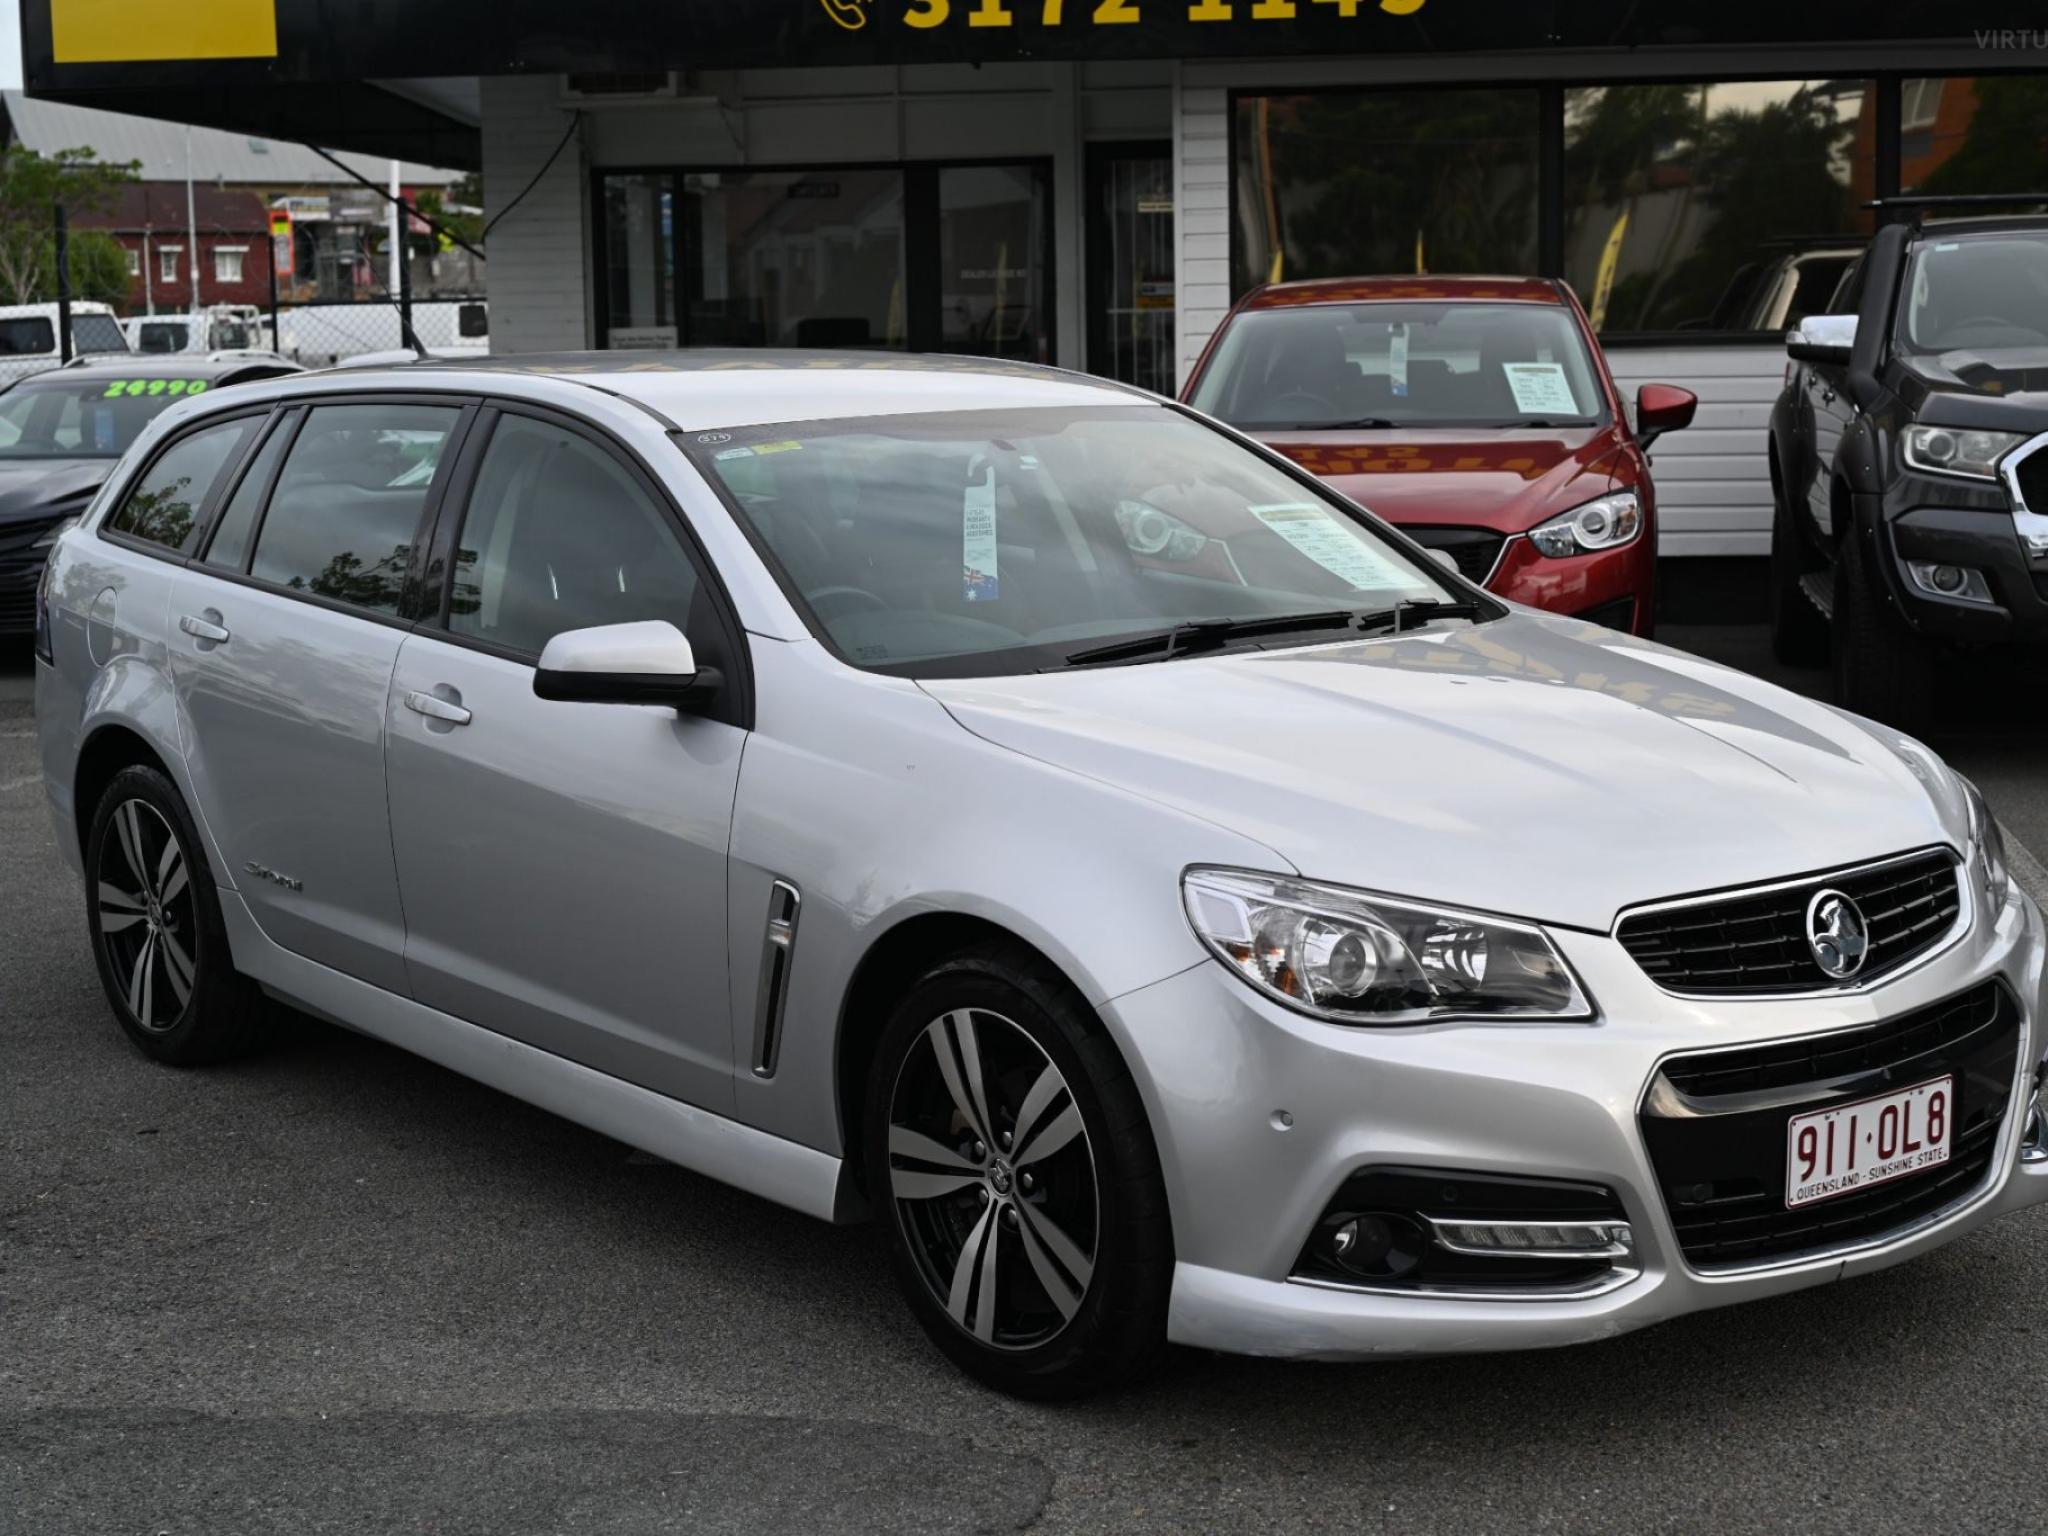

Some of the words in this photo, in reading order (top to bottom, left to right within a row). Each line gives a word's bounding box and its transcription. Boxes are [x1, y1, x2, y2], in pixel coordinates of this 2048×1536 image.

[103, 379, 208, 398] 24990
[1797, 1172, 1860, 1201] QUEENSLAND
[1868, 1158, 1913, 1181] SUNSHINE
[1917, 1147, 1944, 1166] STATE
